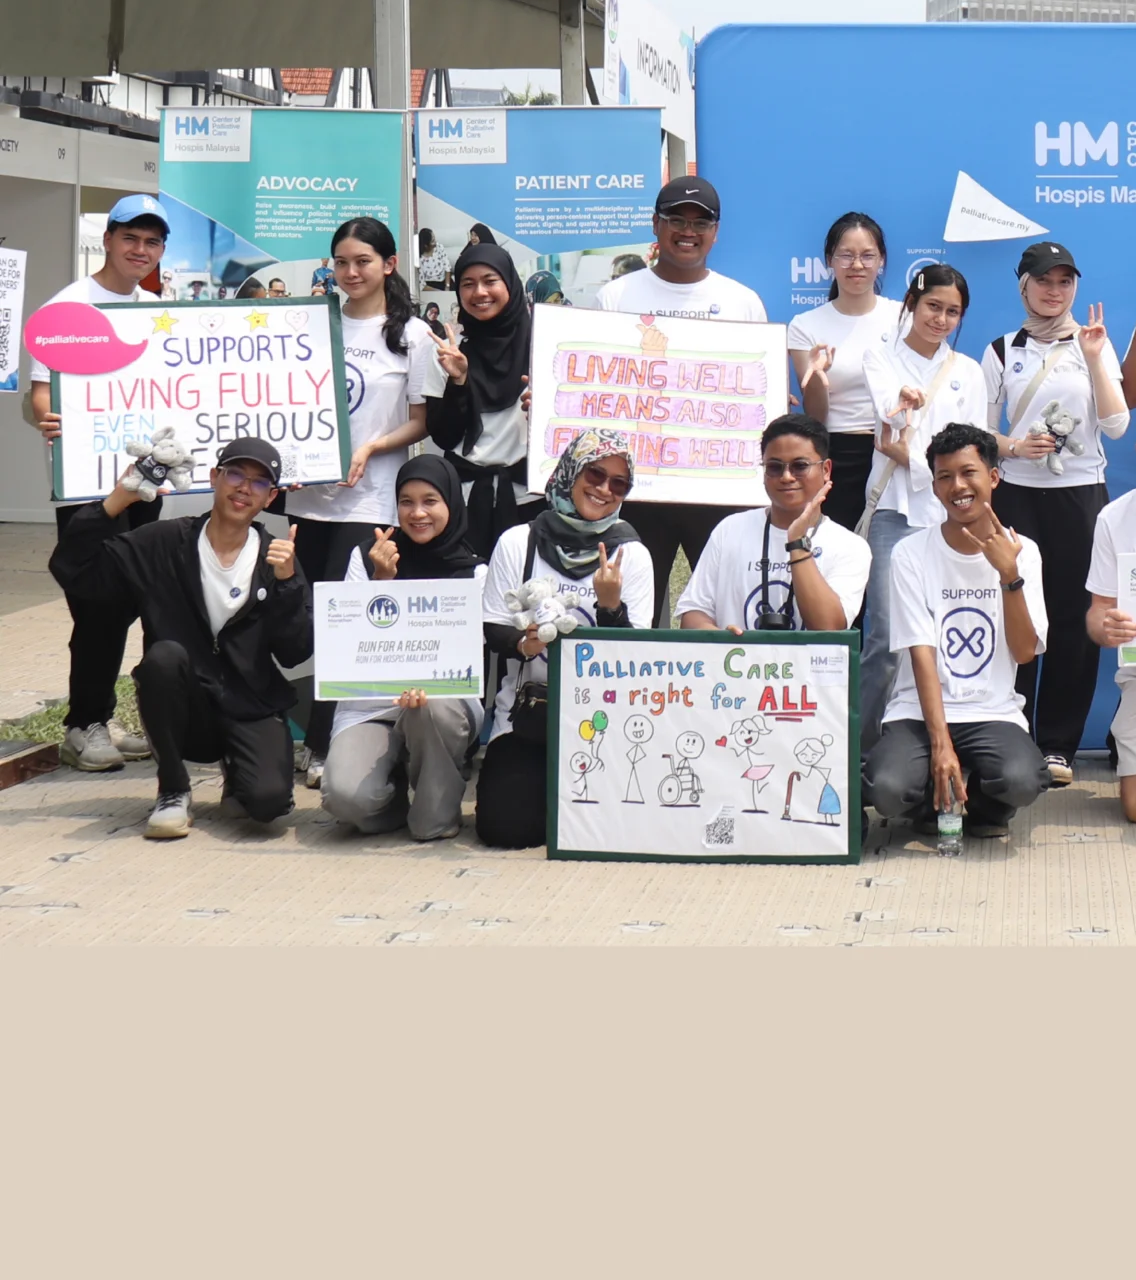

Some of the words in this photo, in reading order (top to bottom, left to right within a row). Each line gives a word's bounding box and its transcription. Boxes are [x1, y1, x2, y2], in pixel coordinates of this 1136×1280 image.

[636, 38, 682, 96] INFORMATION
[175, 116, 210, 136] HM
[428, 118, 463, 138] HM
[57, 148, 66, 160] 09
[175, 143, 204, 152] Hospis
[206, 143, 240, 153] Malaysia
[428, 146, 457, 156] Hospis
[460, 145, 496, 156] Malaysia
[1034, 121, 1119, 167] HM
[144, 161, 156, 173] INFO
[256, 175, 359, 192] ADVOCACY
[515, 174, 591, 190] PATIENT
[595, 173, 645, 189] CARE
[1034, 185, 1106, 208] Hospis
[960, 206, 1030, 233] palliativecare.my
[254, 231, 277, 239] private
[8, 258, 17, 268] QR
[8, 269, 21, 280] FOR
[791, 294, 830, 306] Hospis
[35, 335, 109, 347] #palliativecare
[163, 333, 313, 368] SUPPORTS
[567, 353, 668, 390] LIVING
[676, 362, 756, 395] WELL
[86, 373, 201, 412] LIVING
[218, 369, 331, 409] FULLY
[581, 393, 671, 422] MEANS
[676, 400, 743, 428] ALSO
[93, 413, 155, 434] EVEN
[195, 409, 335, 444] SERIOUS
[688, 439, 754, 468] WELL
[942, 588, 998, 600] SUPPORT
[357, 640, 376, 653] RUN
[378, 640, 394, 652] FOR
[397, 640, 403, 652] A
[405, 639, 440, 652] REASON
[575, 642, 705, 678] PALLIATIVE
[724, 647, 794, 680] CARE
[810, 656, 828, 665] HM
[574, 686, 591, 705] is
[603, 689, 617, 704] a
[629, 682, 694, 716] right
[711, 683, 747, 710] for
[758, 685, 818, 711] ALL
